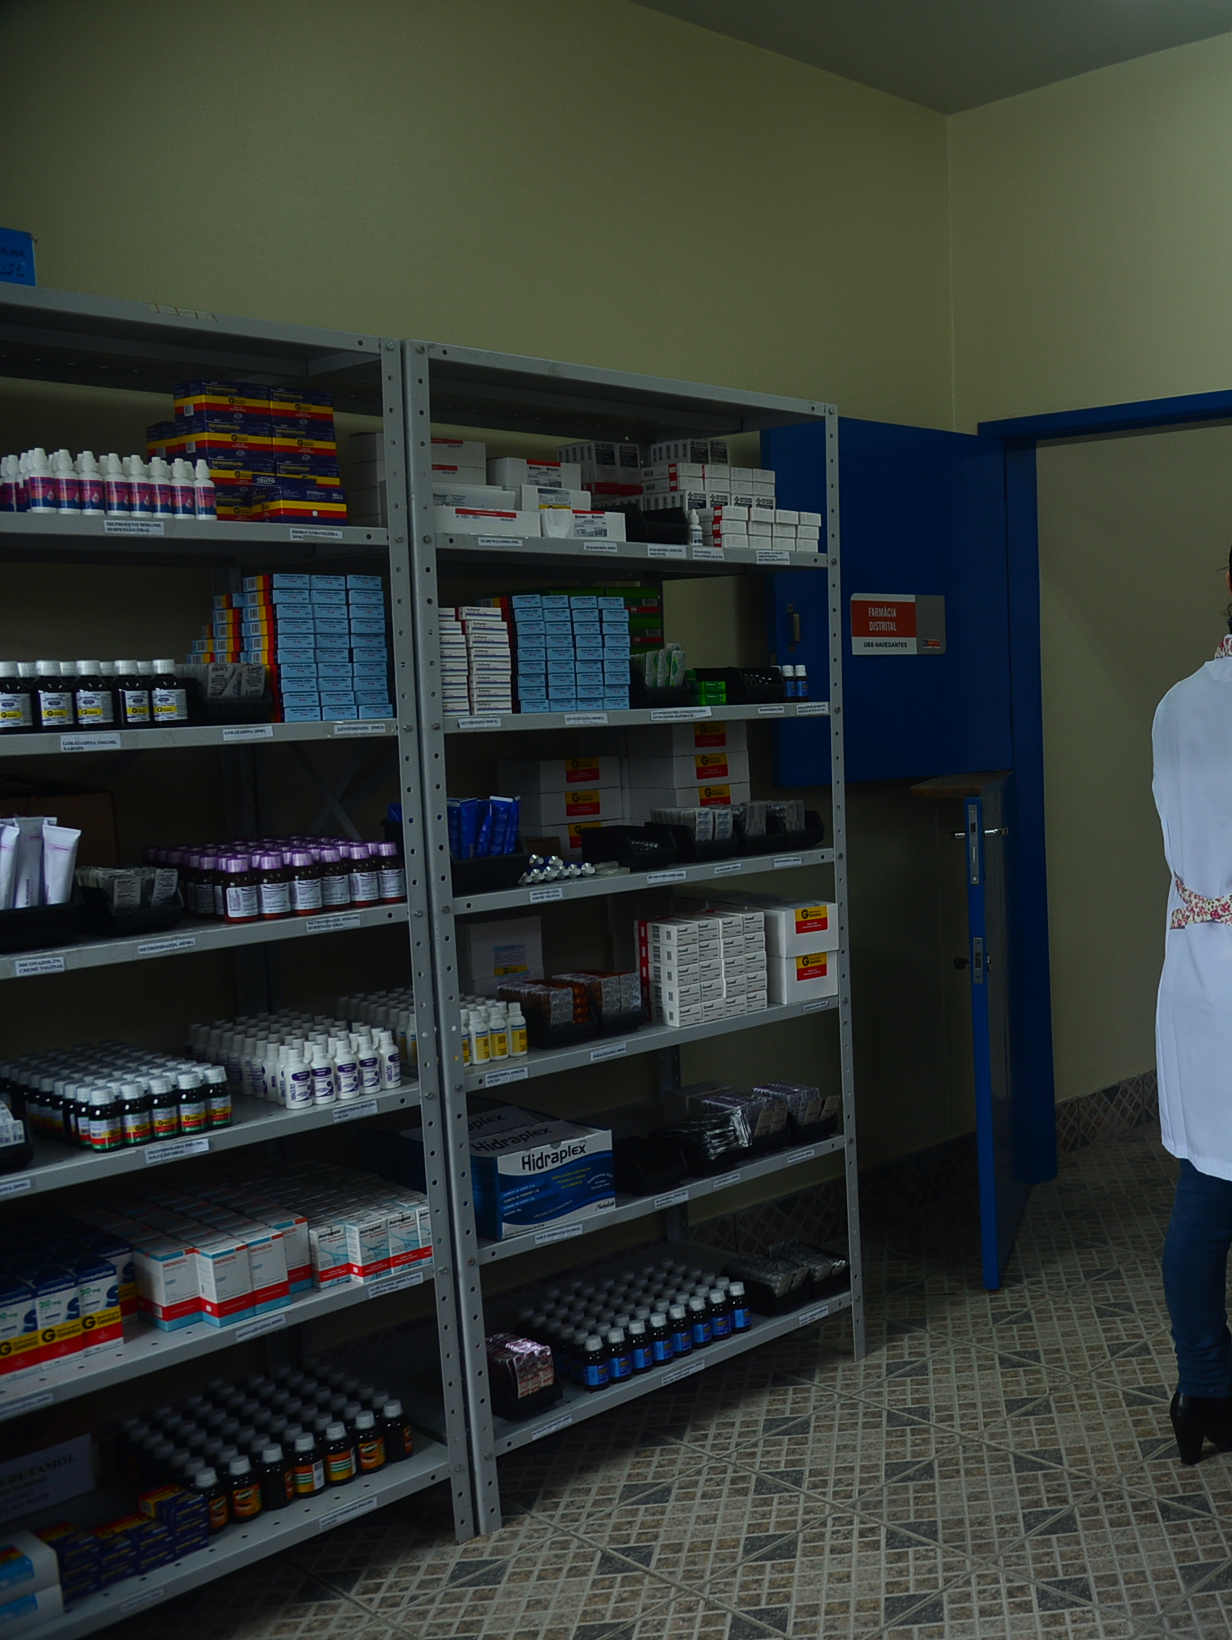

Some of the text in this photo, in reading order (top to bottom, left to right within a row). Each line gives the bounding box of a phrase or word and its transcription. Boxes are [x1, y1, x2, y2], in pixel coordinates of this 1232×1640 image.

[868, 606, 897, 618] FARMÁCIA
[869, 621, 897, 632] DISTRITAL
[468, 1112, 506, 1132] aplex
[471, 1127, 553, 1152] Hidraplex
[521, 1144, 586, 1172] Hidraplex
[39, 1300, 51, 1308] 20
[82, 1316, 96, 1329] G
[42, 1328, 56, 1342] G
